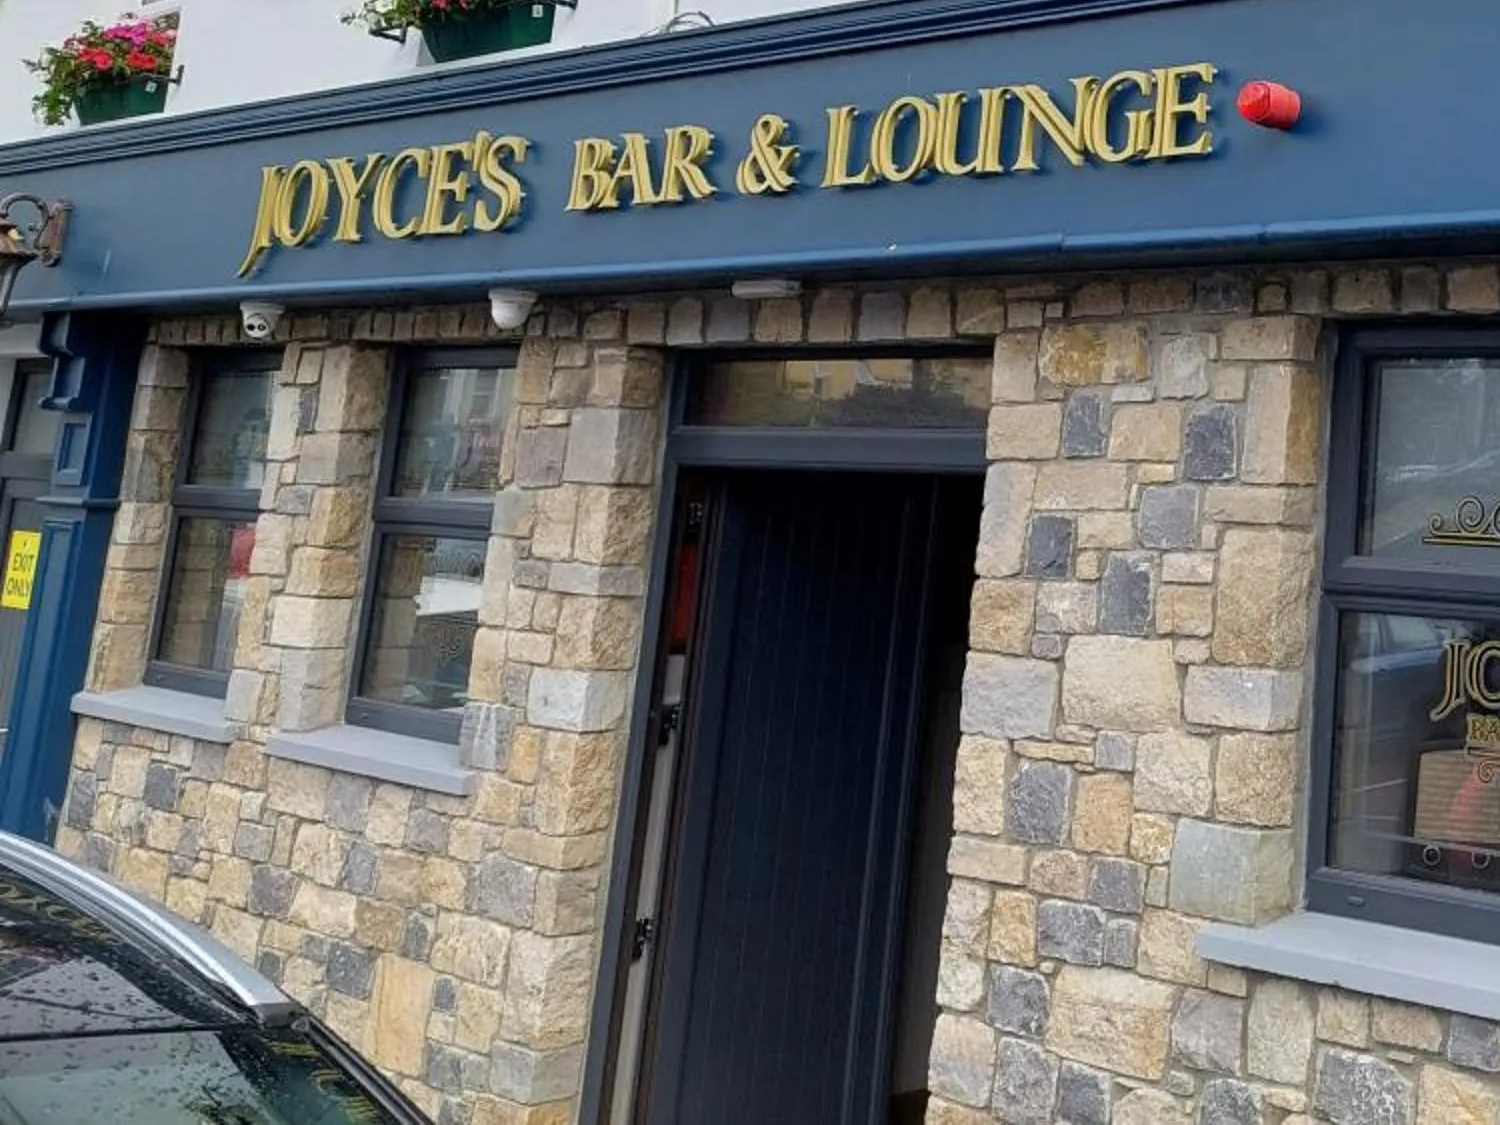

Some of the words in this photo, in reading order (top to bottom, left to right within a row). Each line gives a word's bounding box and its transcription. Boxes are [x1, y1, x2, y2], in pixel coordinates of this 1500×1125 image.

[236, 129, 533, 277] JOYCE'S
[564, 123, 717, 213] BAR
[736, 113, 800, 194] &
[820, 61, 1219, 189] LOUNGE
